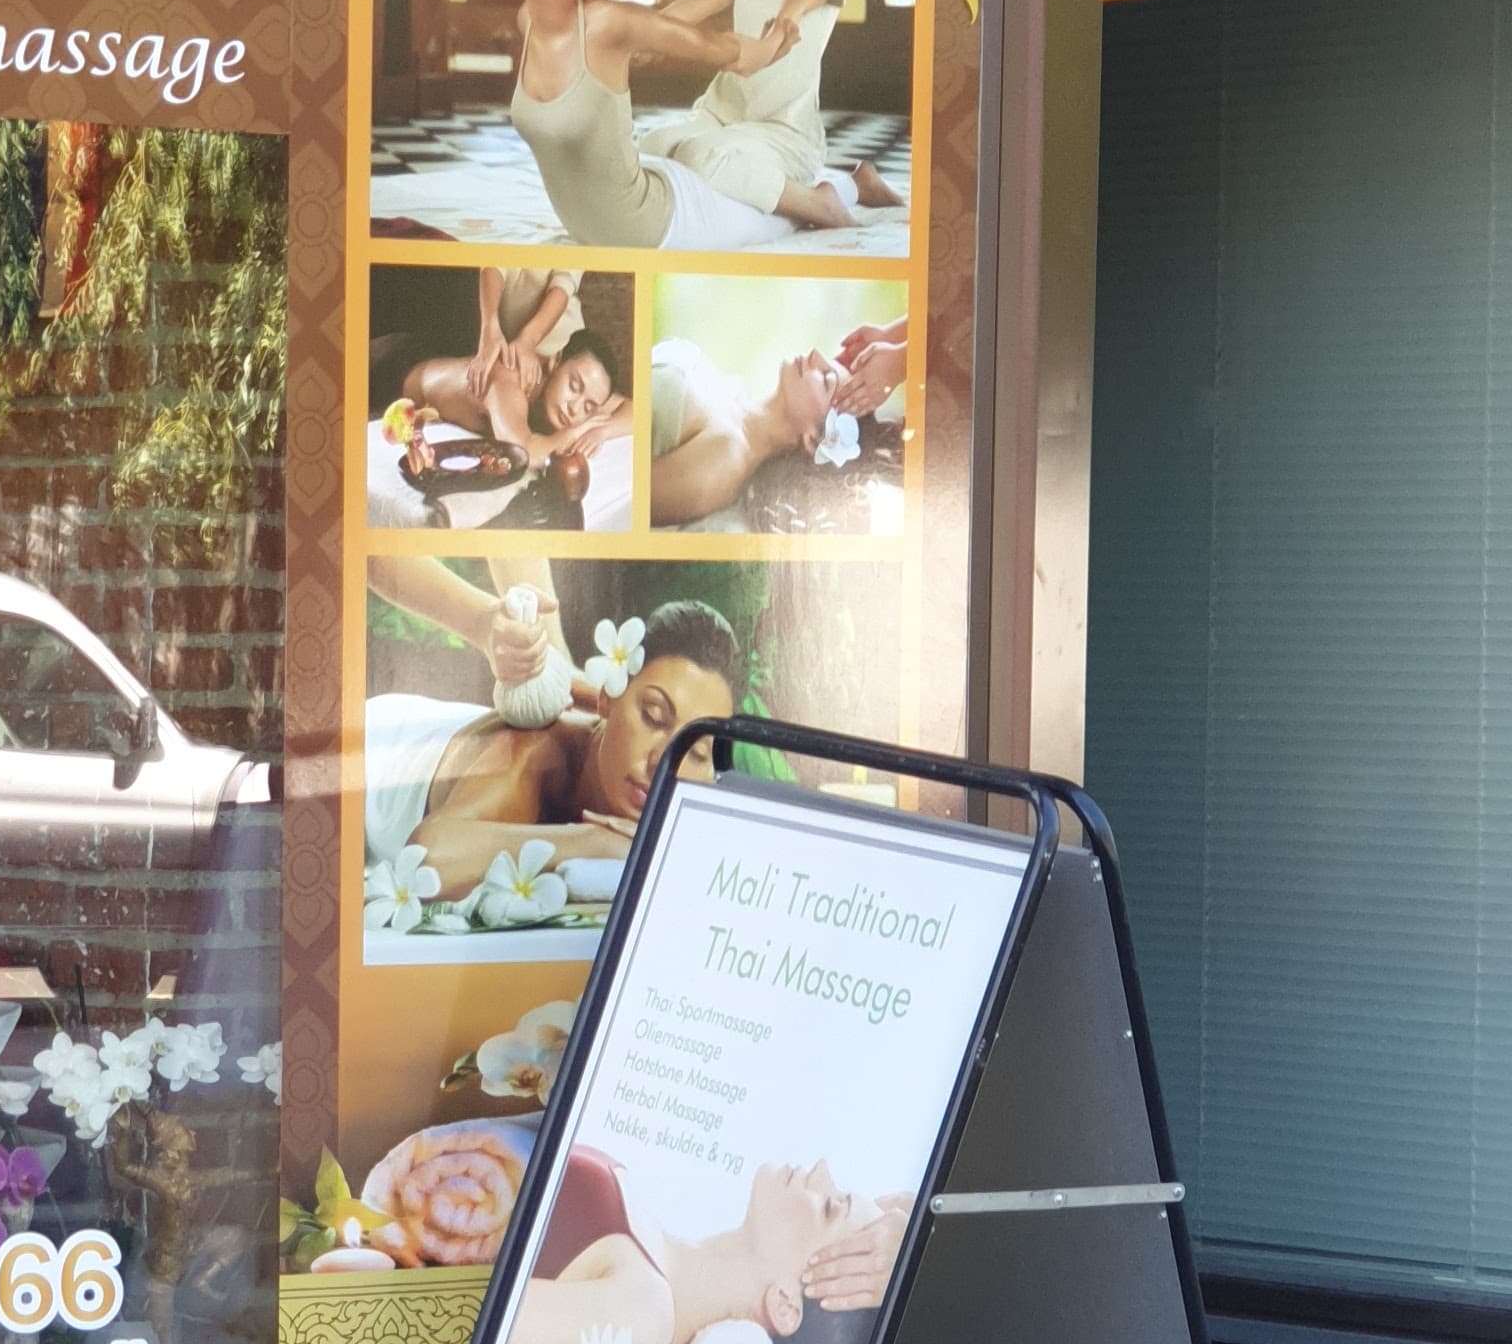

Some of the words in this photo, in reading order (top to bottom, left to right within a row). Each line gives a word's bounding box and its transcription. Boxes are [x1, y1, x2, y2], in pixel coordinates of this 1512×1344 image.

[707, 857, 779, 909] Mali
[788, 872, 956, 950] Traditional
[705, 925, 772, 981] Thai
[773, 945, 911, 1024] Massage
[634, 1018, 723, 1063] Oliemassage
[645, 987, 672, 1010] Thai
[676, 996, 773, 1042] Sportmassage
[624, 1048, 684, 1083] Hotstone
[687, 1068, 747, 1105] Massage
[613, 1080, 663, 1110] Herbal
[663, 1096, 724, 1133] Massage
[603, 1111, 650, 1145] Nakke,
[656, 1127, 705, 1158] skuldre
[707, 1141, 719, 1163] &
[722, 1151, 745, 1175] ryg
